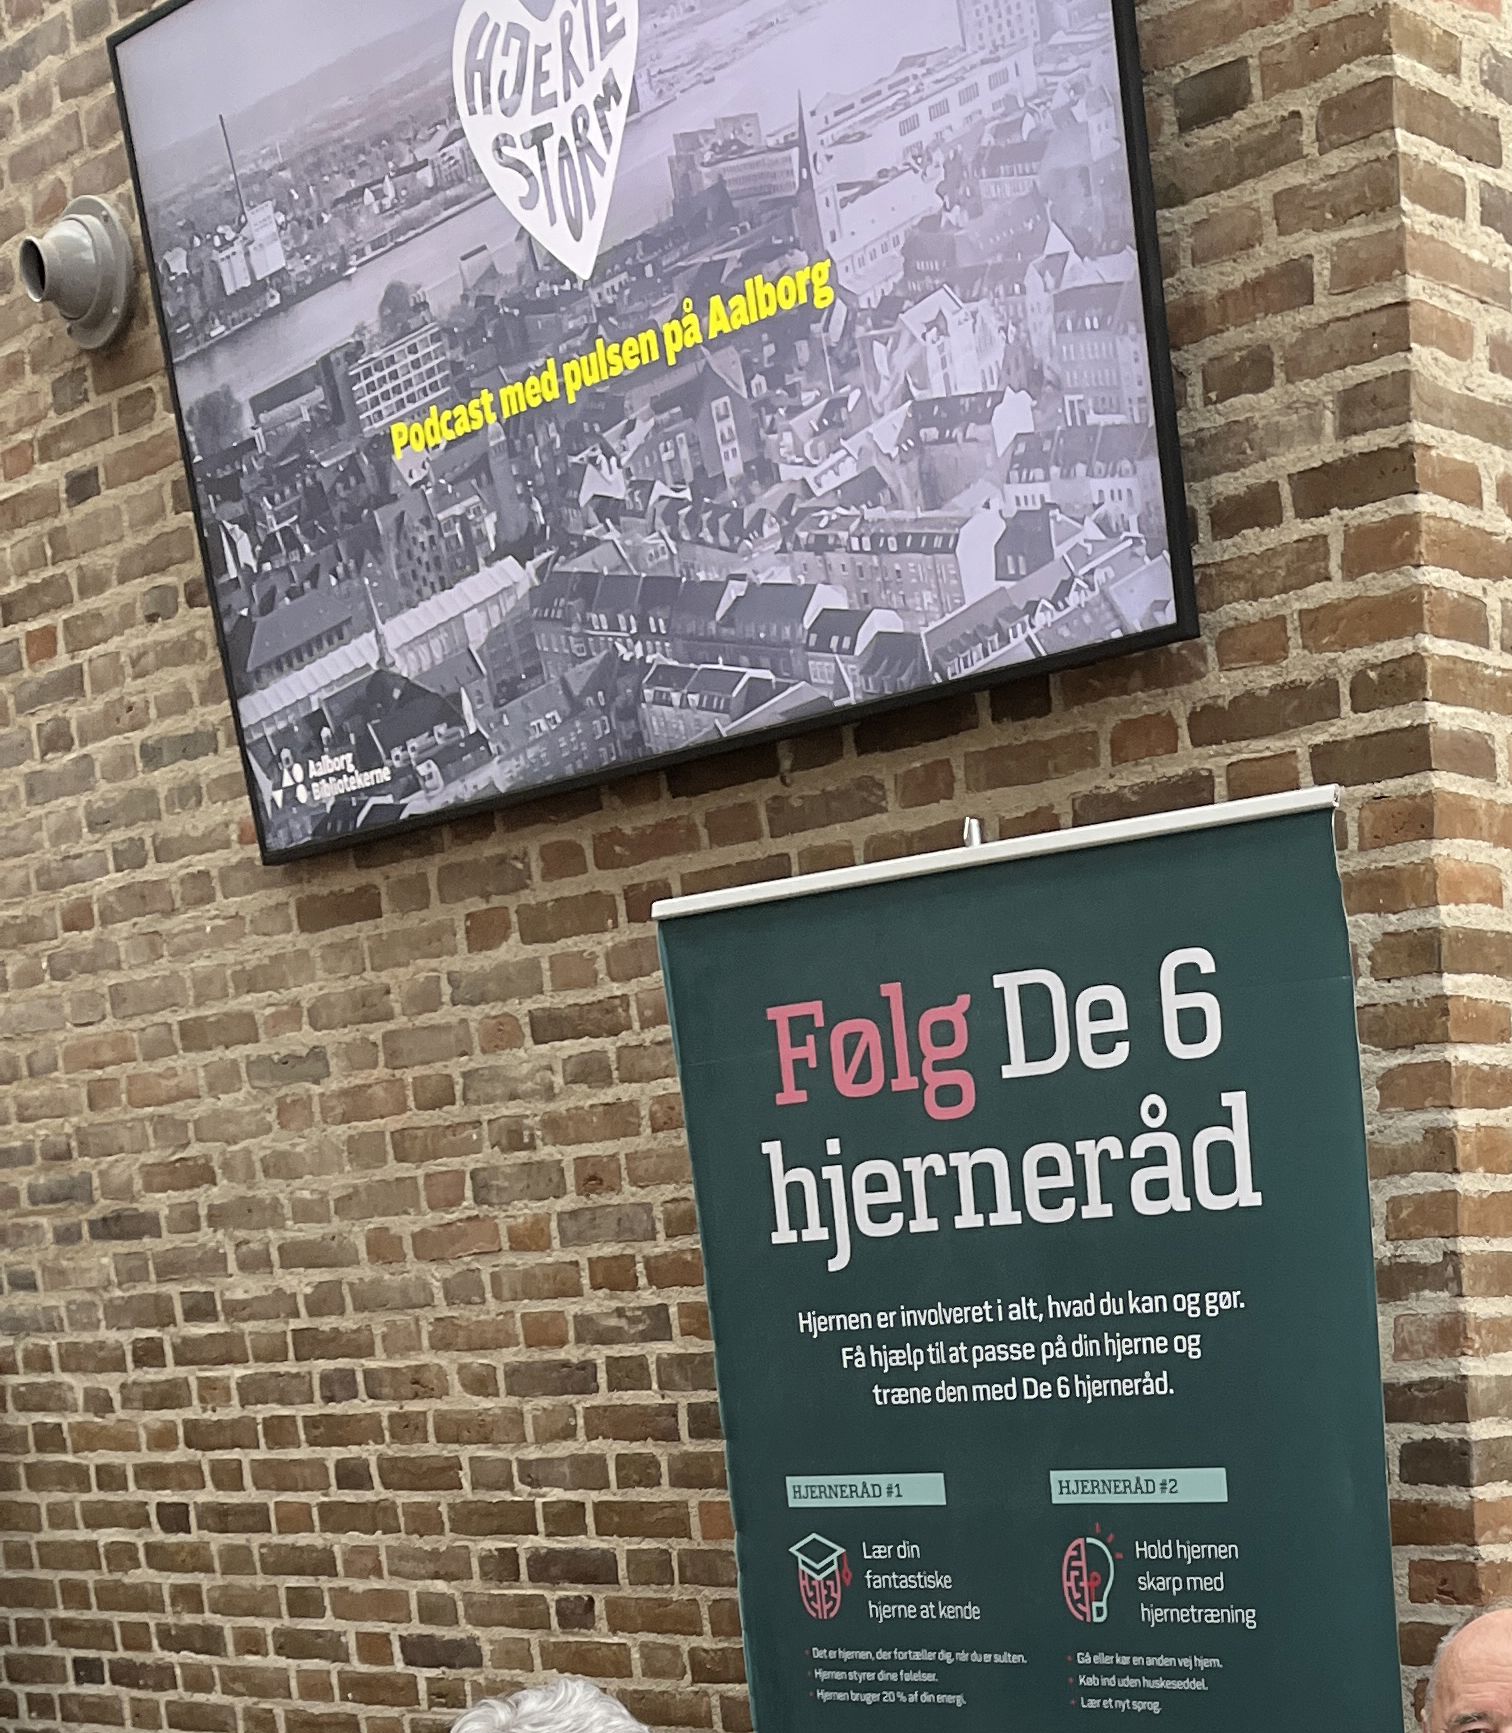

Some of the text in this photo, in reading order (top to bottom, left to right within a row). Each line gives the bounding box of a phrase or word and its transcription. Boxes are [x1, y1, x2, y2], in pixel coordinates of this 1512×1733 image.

[492, 67, 623, 242] STORM
[391, 257, 836, 460] Podcast med pulsen på Aalborg
[308, 752, 355, 778] Aalborg
[311, 766, 391, 800] Bibliotekerne
[766, 947, 1223, 1121] Følg De 6
[761, 1090, 1263, 1272] hjerneråd
[798, 1290, 1246, 1338] Hjernen er involveret i alt, hvad du kan og gør.
[841, 1332, 1202, 1373] Få hjælp til at passe på din hjerne og
[872, 1370, 1174, 1405] træne den med De 6 hjerneråd.
[792, 1481, 903, 1500] HJERNERÅD #1
[1058, 1475, 1179, 1496] HJERNERÅD #2
[862, 1540, 921, 1559] Lær din
[1135, 1539, 1239, 1565] Hold hjernen
[865, 1569, 953, 1589] fantastiske
[1137, 1570, 1225, 1596] skarp med
[868, 1600, 981, 1623] hjerne at kende
[1140, 1602, 1257, 1630] hjernetræning
[812, 1647, 828, 1659] Det
[828, 1649, 837, 1659] er
[838, 1648, 875, 1662] hjernen,
[875, 1648, 892, 1660] der
[893, 1647, 937, 1661] fortæller
[970, 1650, 983, 1663] du
[983, 1653, 992, 1663] er
[993, 1651, 1028, 1664] sulten.
[1076, 1652, 1092, 1665] Gå
[1093, 1652, 1115, 1665] eller
[1115, 1653, 1131, 1665] kør
[1132, 1656, 1145, 1666] en
[1145, 1655, 1177, 1668] anden
[1178, 1656, 1193, 1670] vej
[814, 1668, 939, 1684] Hjernen styrer dine følelser.
[1078, 1675, 1209, 1690] Køb ind uden huskeseddel.
[816, 1689, 850, 1703] Hjernen
[849, 1690, 881, 1705] bruger
[881, 1690, 896, 1702] 20
[896, 1691, 907, 1702] %
[907, 1690, 919, 1703] af
[920, 1691, 936, 1703] din
[1080, 1697, 1162, 1714] Lær et nyt sprog.
